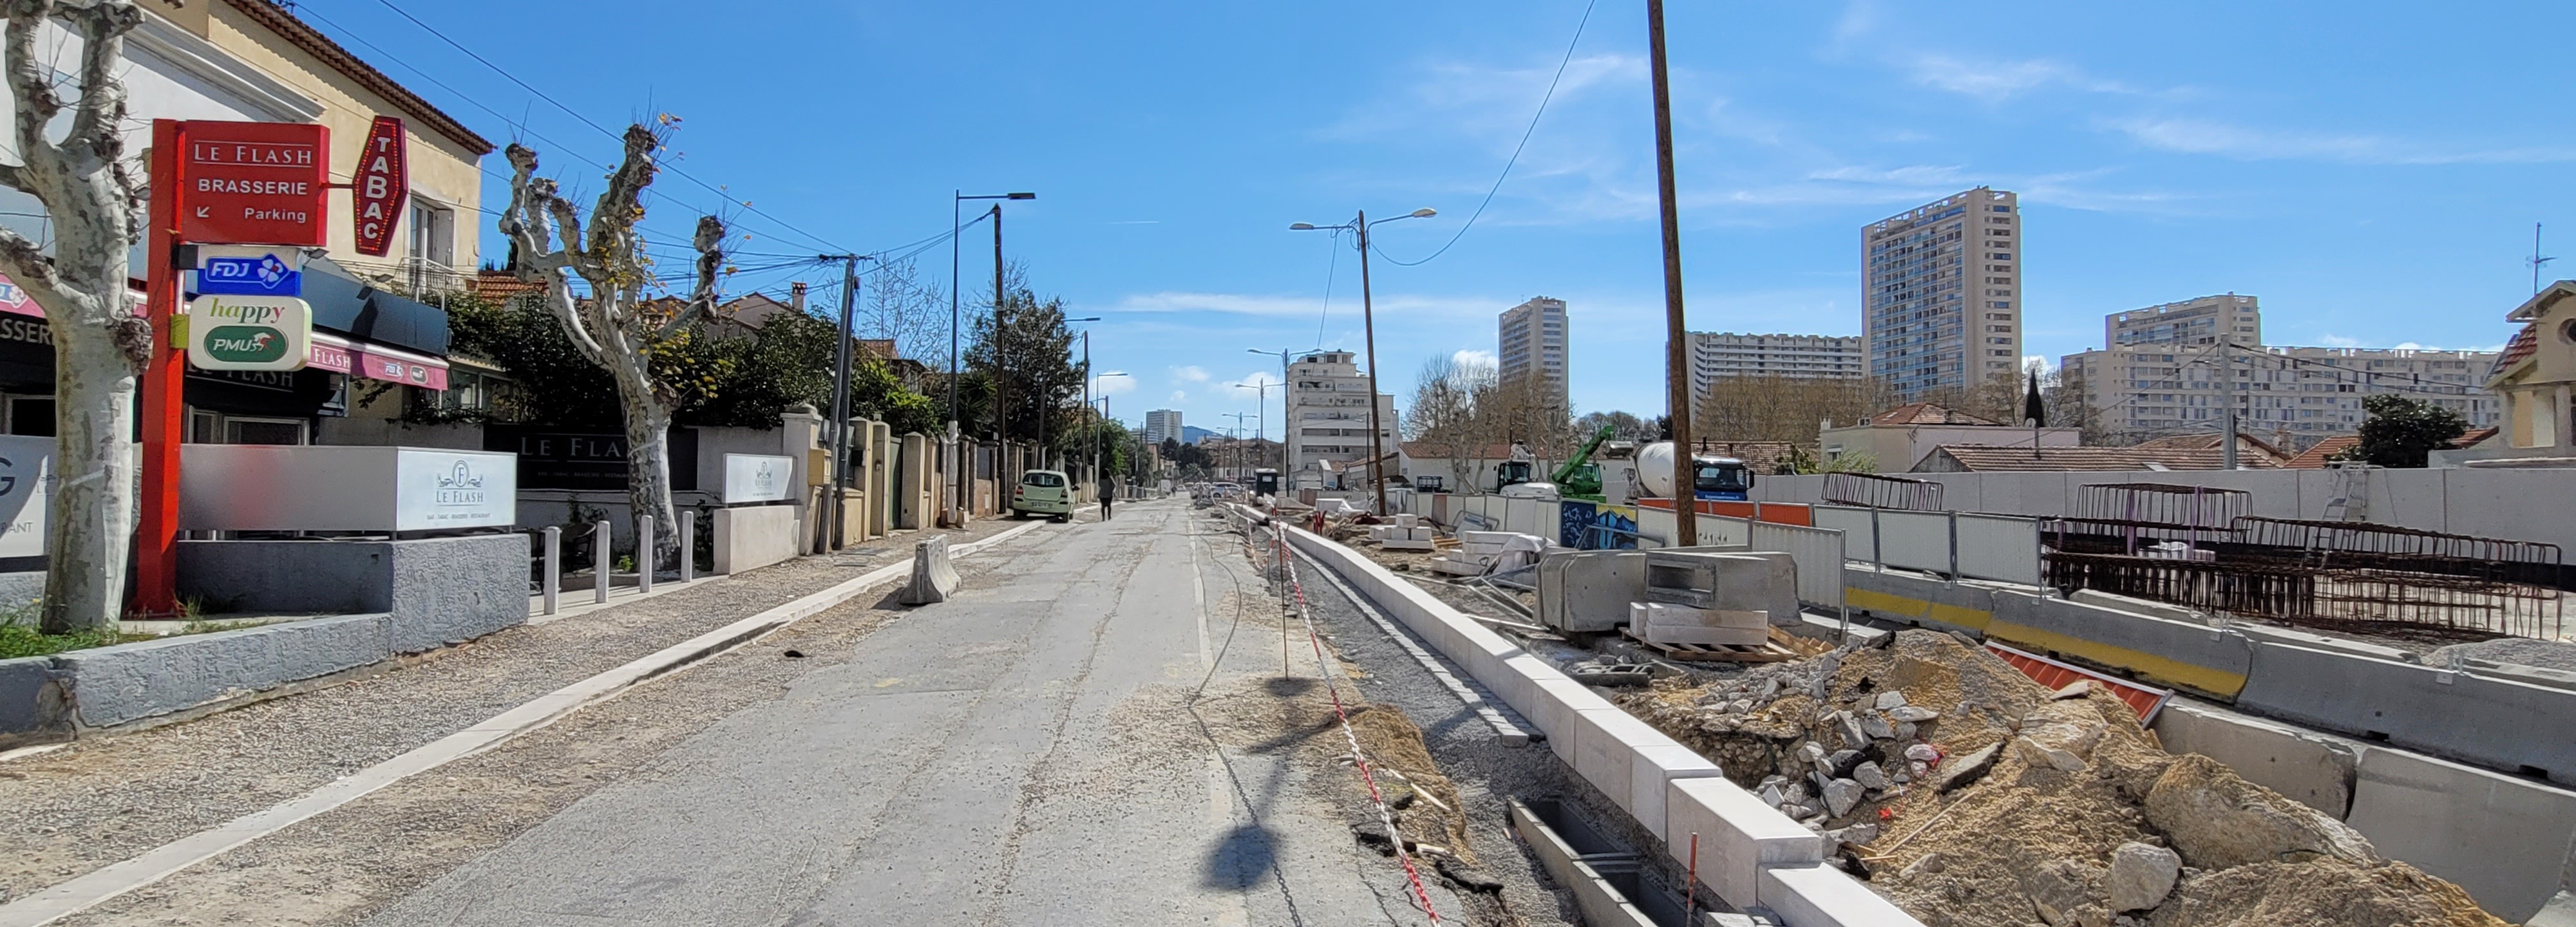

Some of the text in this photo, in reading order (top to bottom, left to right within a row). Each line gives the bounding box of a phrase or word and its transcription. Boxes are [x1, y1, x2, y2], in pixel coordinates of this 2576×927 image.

[194, 144, 312, 164] LE FLASH
[198, 178, 308, 195] BRASSERIE
[363, 136, 391, 239] TABAC
[245, 207, 307, 223] Parking
[210, 262, 250, 277] FDJ
[209, 297, 285, 324] happy
[213, 339, 252, 352] PMU
[314, 348, 351, 368] FLASH
[521, 436, 551, 456] LE
[436, 491, 484, 503] LE FLASH
